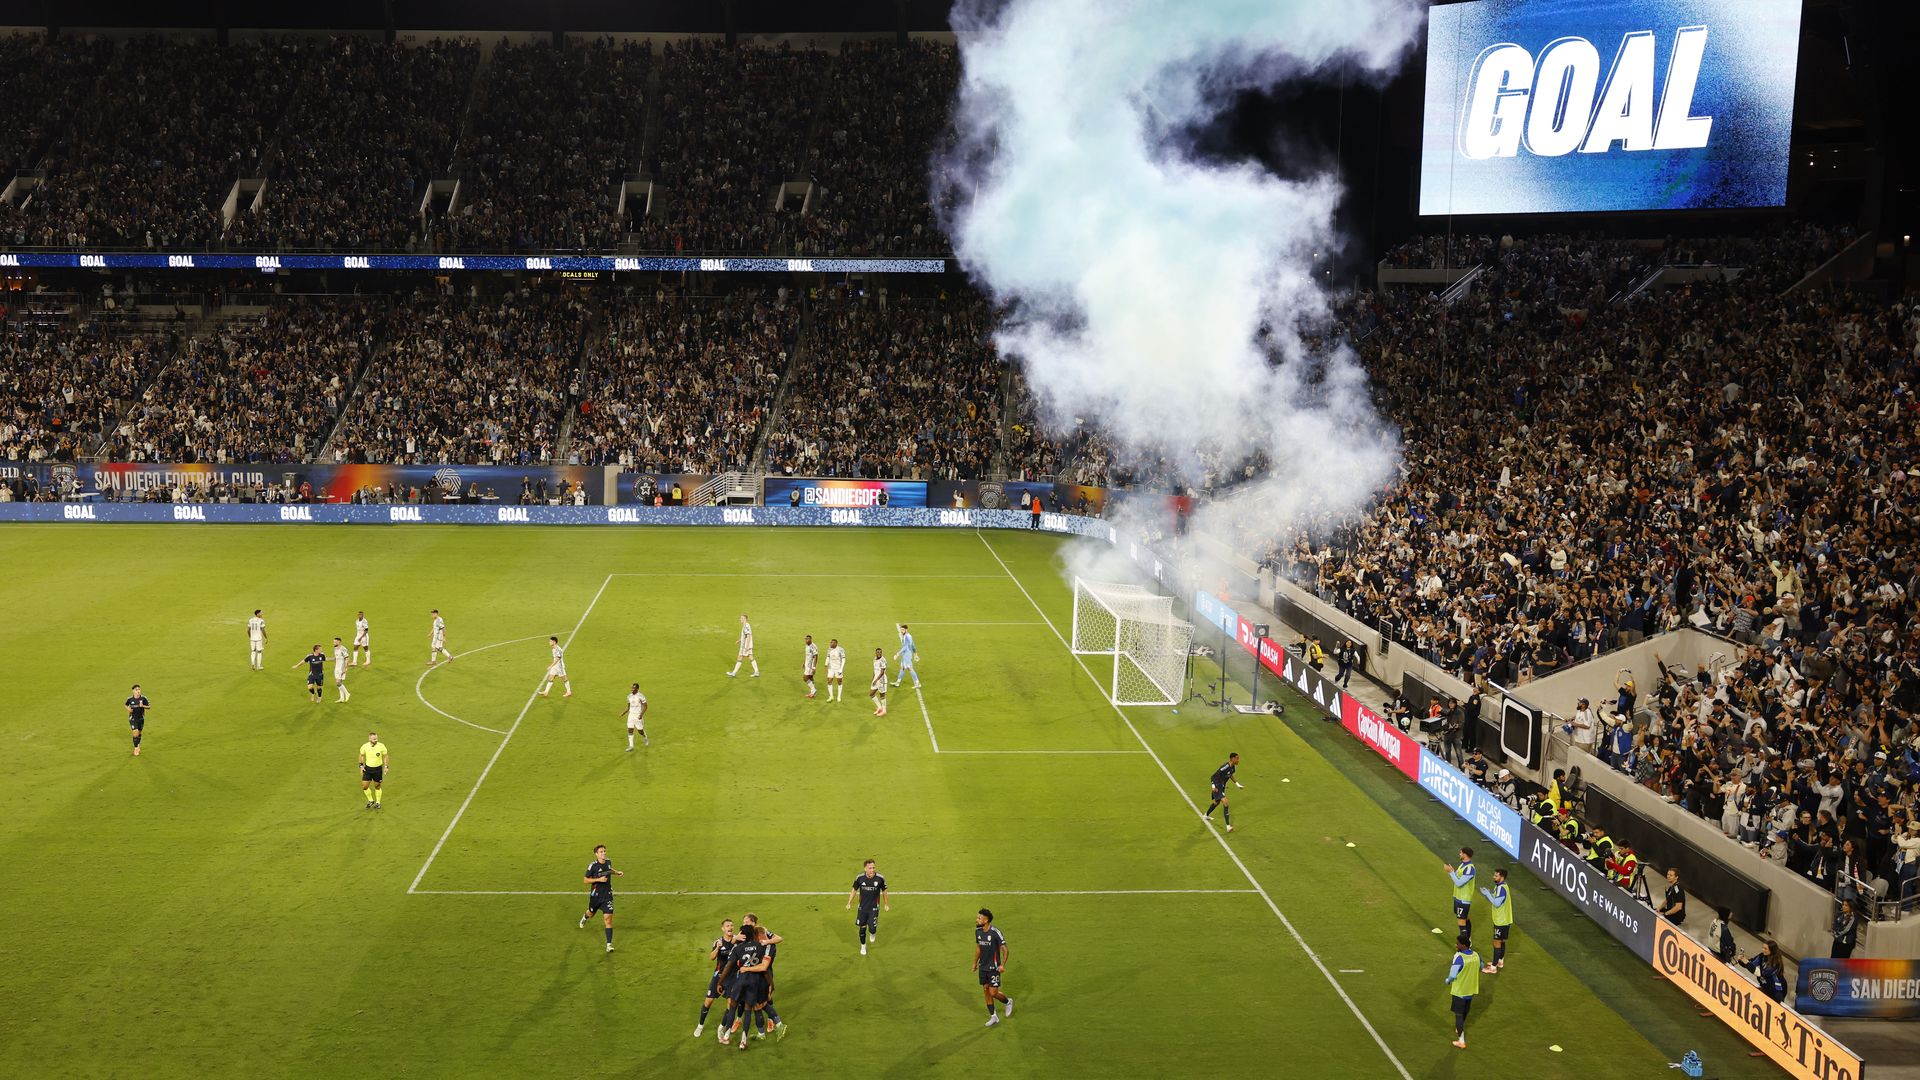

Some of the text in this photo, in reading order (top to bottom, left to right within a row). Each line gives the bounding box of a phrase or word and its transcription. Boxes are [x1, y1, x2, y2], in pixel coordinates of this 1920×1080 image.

[1458, 25, 1713, 160] GOAL
[0, 254, 20, 266] OAL
[81, 255, 106, 267] GOAL
[169, 255, 195, 267] GOAL
[255, 256, 282, 267] GOAL
[345, 256, 370, 268] GOAL
[440, 257, 465, 269] GOAL
[526, 257, 552, 269] GOAL
[615, 258, 640, 270] GOAL
[701, 259, 726, 271] GOAL
[788, 259, 814, 271] GOAL
[94, 471, 264, 491] SAN DIEGO FOOTBALL CLUB
[64, 505, 96, 519] GOAL
[174, 505, 206, 520] GOAL
[280, 506, 312, 520] GOAL
[390, 506, 422, 521] GOAL
[498, 507, 530, 521] GOAL
[608, 508, 640, 522] GOAL
[724, 508, 755, 522] GOAL
[831, 509, 862, 523] GOAL
[940, 510, 972, 525] GOAL
[1044, 514, 1069, 531] GOAL
[1249, 631, 1279, 666] DORDASH
[1358, 706, 1400, 762] Captain Morgan
[1422, 755, 1474, 815] DIRECTV
[1478, 795, 1502, 823] LA CASA
[1477, 810, 1514, 849] DEL FÚTBOL
[1592, 890, 1639, 934] REWARDS
[742, 952, 760, 967] 26
[991, 975, 999, 983] 20
[1659, 929, 1772, 1041] Continental
[1851, 978, 1920, 999] SAN DIEGO
